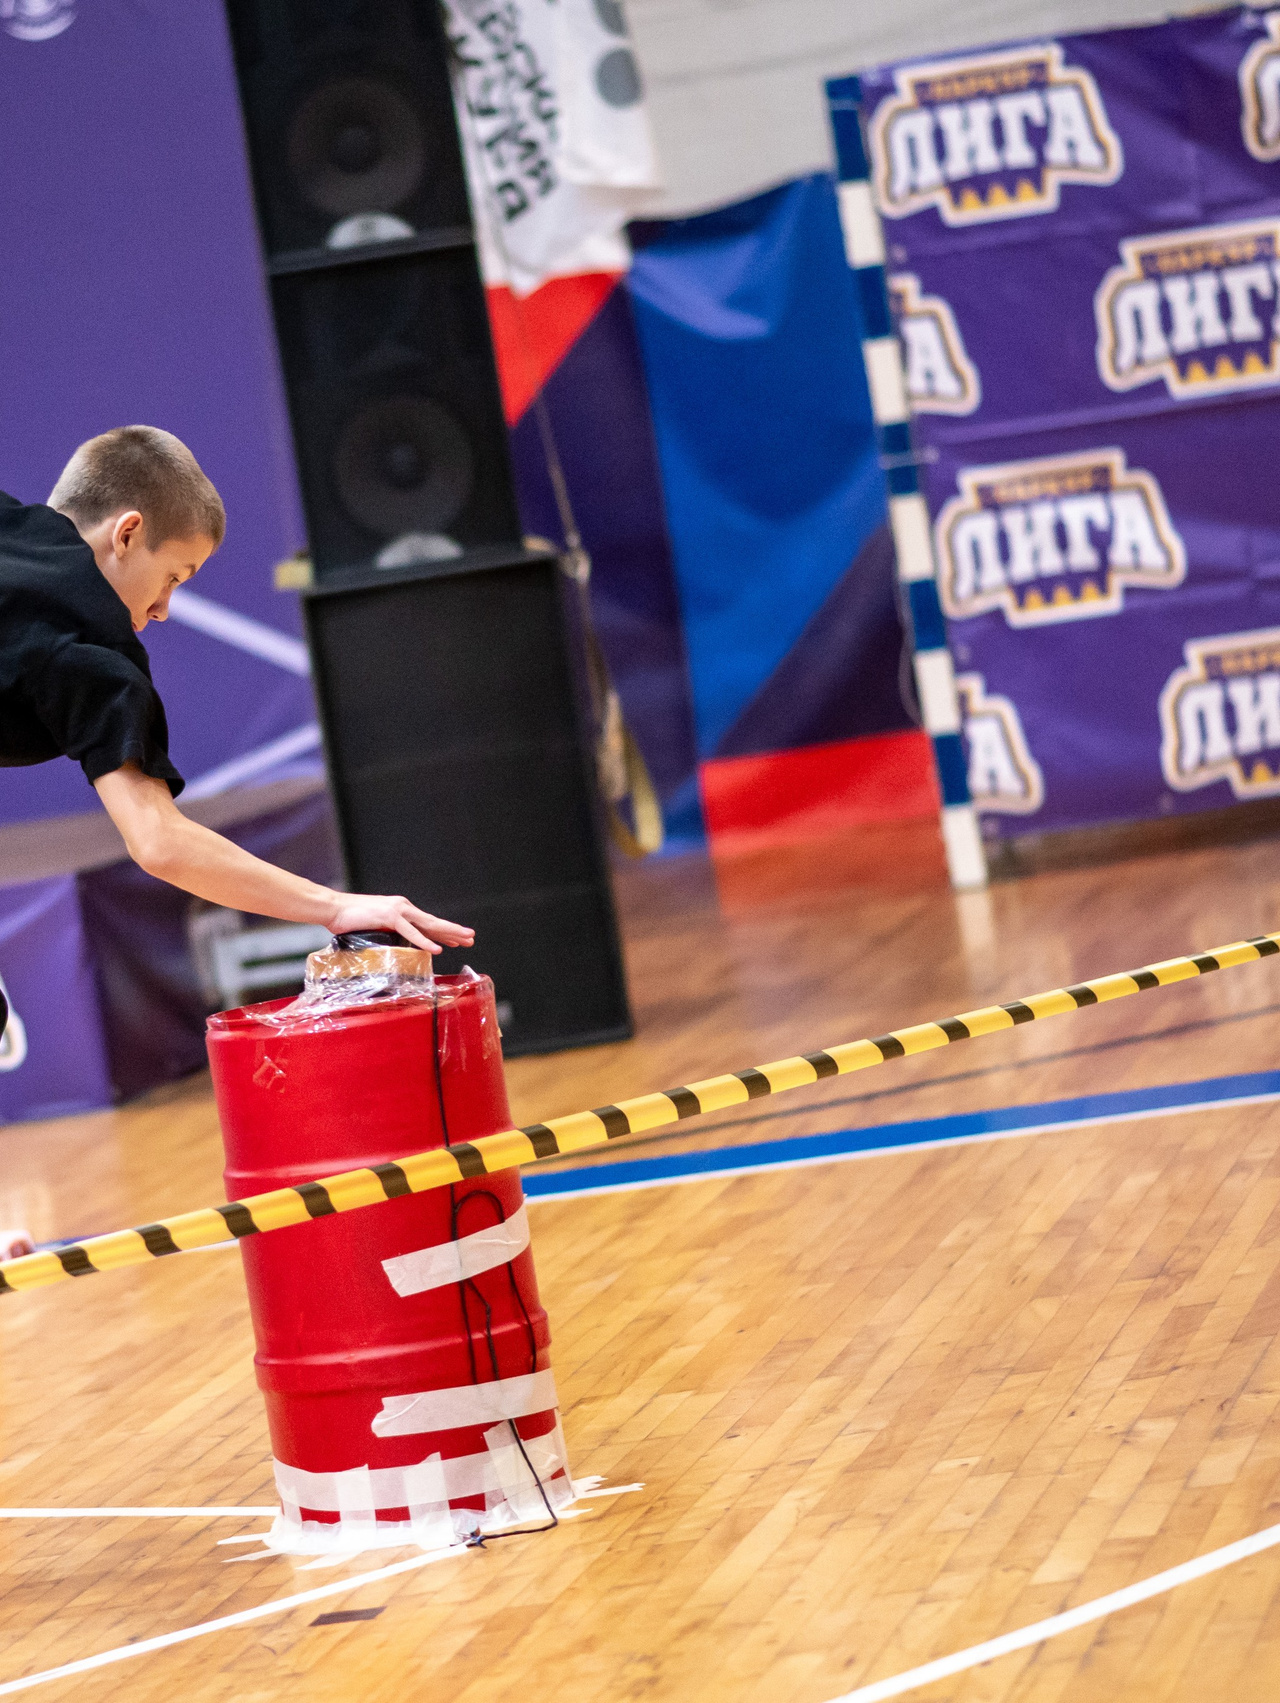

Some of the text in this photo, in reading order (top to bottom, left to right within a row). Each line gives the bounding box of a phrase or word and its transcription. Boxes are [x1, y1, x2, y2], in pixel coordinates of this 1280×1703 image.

[889, 86, 1105, 201] ЛИГА
[1112, 261, 1280, 374] ЛИГ
[951, 489, 1169, 600] ЛИГА
[1177, 671, 1280, 772] ЛИ
